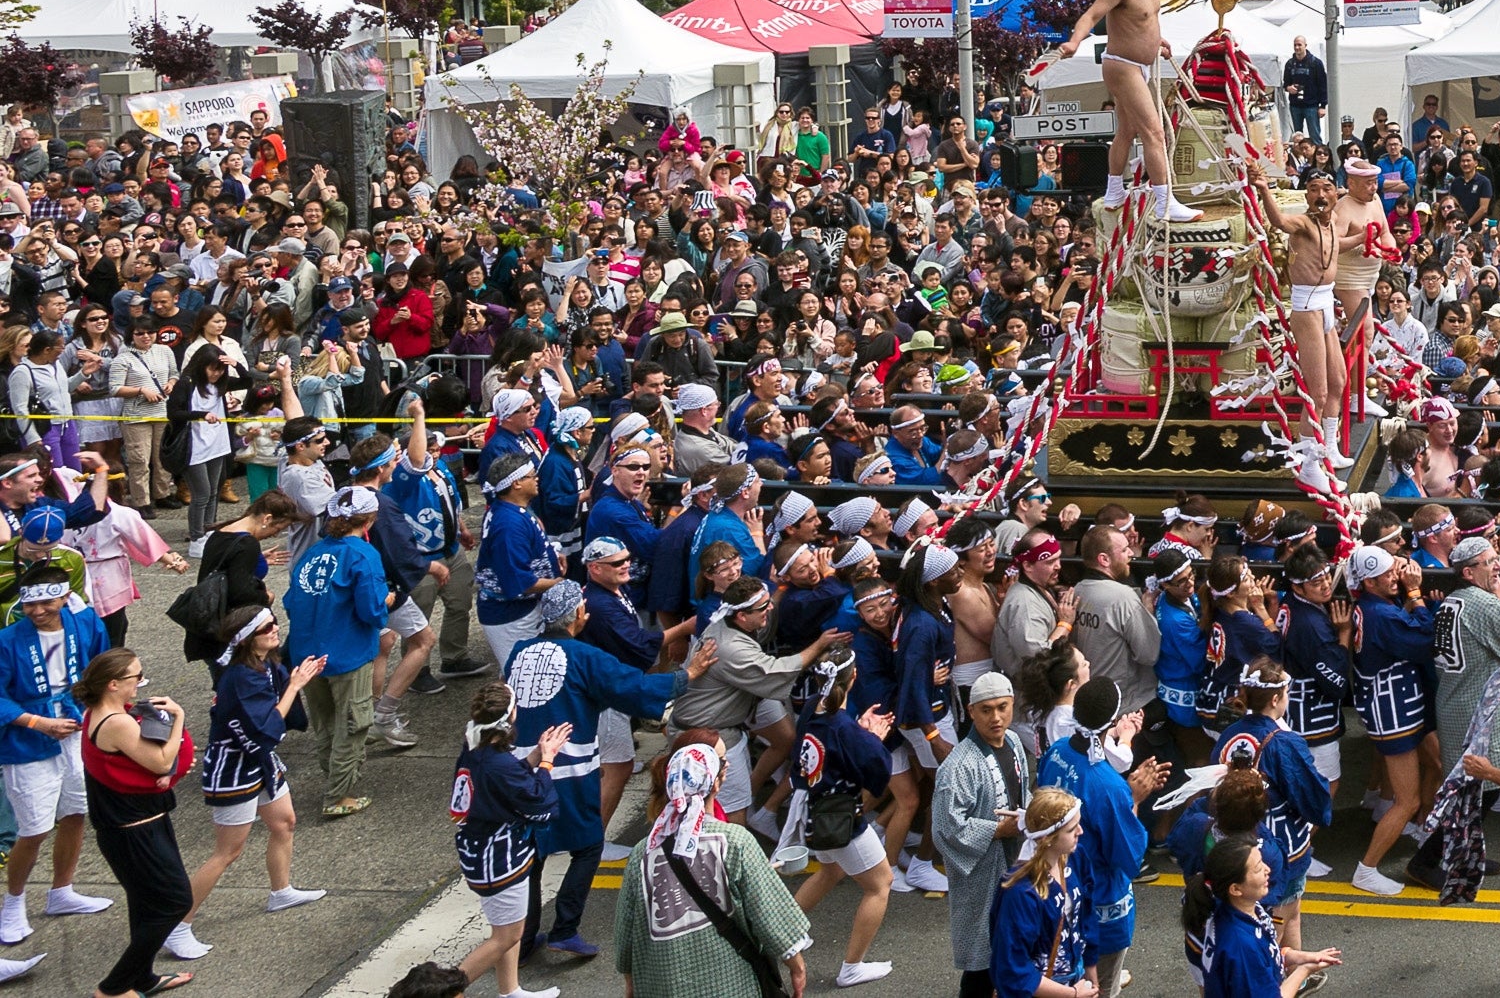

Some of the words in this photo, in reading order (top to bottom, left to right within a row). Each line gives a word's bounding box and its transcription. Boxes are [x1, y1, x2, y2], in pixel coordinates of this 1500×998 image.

[752, 9, 811, 39] xfinity
[892, 17, 945, 28] TOYOTA
[185, 97, 235, 116] SAPPORO
[1057, 103, 1077, 113] 1700
[167, 123, 208, 137] Welcom
[1038, 117, 1090, 133] POST
[1316, 662, 1346, 688] OZEKI
